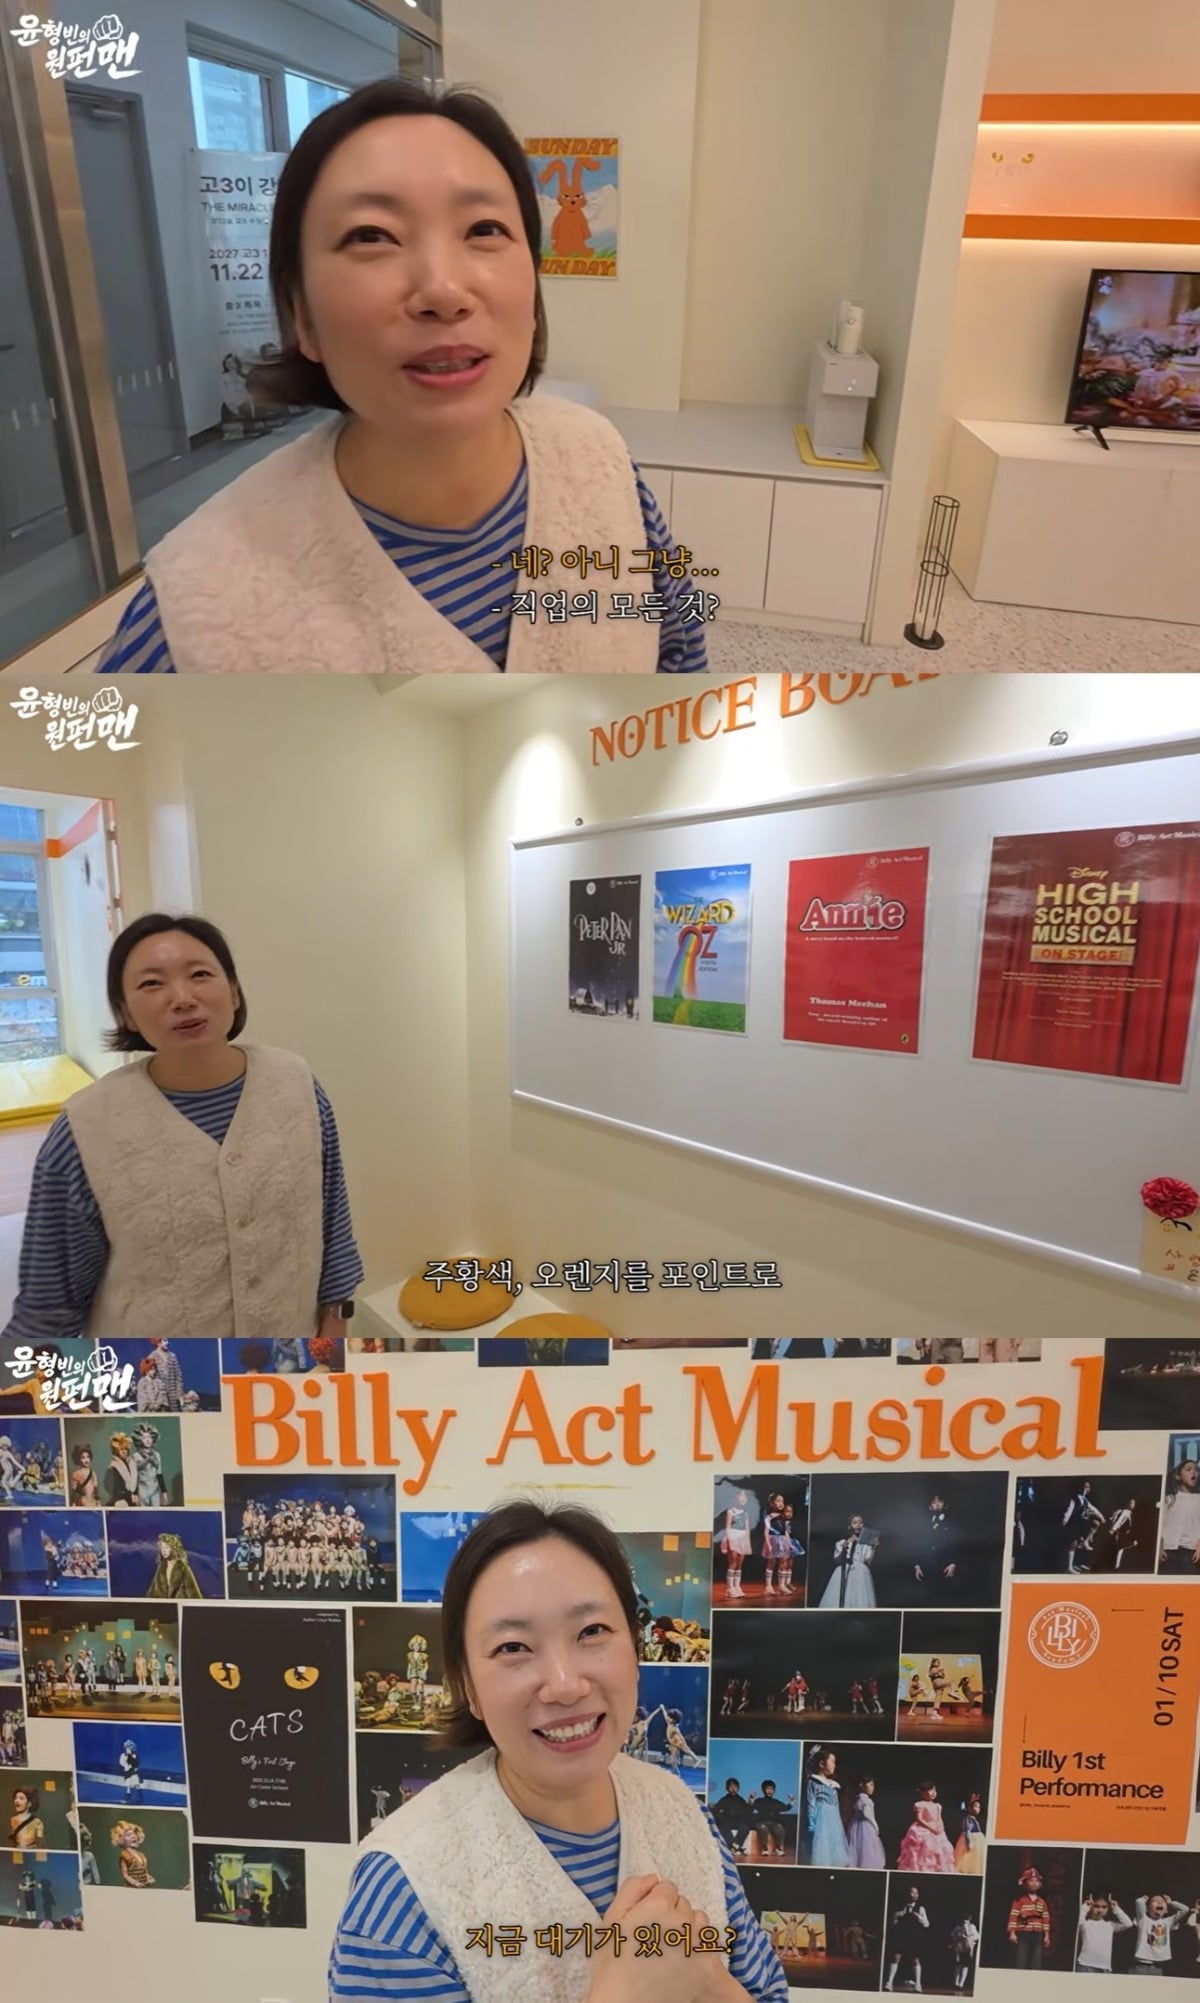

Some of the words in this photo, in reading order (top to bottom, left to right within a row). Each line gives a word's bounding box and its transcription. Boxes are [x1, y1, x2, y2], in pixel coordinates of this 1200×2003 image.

[200, 176, 253, 196] 고3이
[201, 202, 225, 212] THE
[209, 249, 239, 259] 2027
[210, 263, 264, 281] 11.22
[541, 260, 616, 276] UNDAY
[589, 676, 756, 766] NOTICE
[1036, 881, 1140, 906] HIGH
[662, 899, 736, 925] WIZARD
[799, 895, 906, 932] Annie
[1034, 905, 1137, 926] SCHOOL
[574, 913, 611, 944] PETER
[610, 911, 633, 941] PAN
[1032, 925, 1137, 944] MUSICAL
[609, 941, 626, 956] JR
[678, 924, 718, 959] OZ
[1040, 947, 1064, 960] ON
[809, 997, 846, 1007] Thomas
[221, 1371, 457, 1496] Billy
[485, 1369, 656, 1466] Act
[682, 1356, 1107, 1463] Musical
[229, 1708, 304, 1741] CATS
[1021, 1750, 1068, 1774] Billy
[1072, 1752, 1106, 1770] 1st
[1020, 1776, 1164, 1799] Performance
